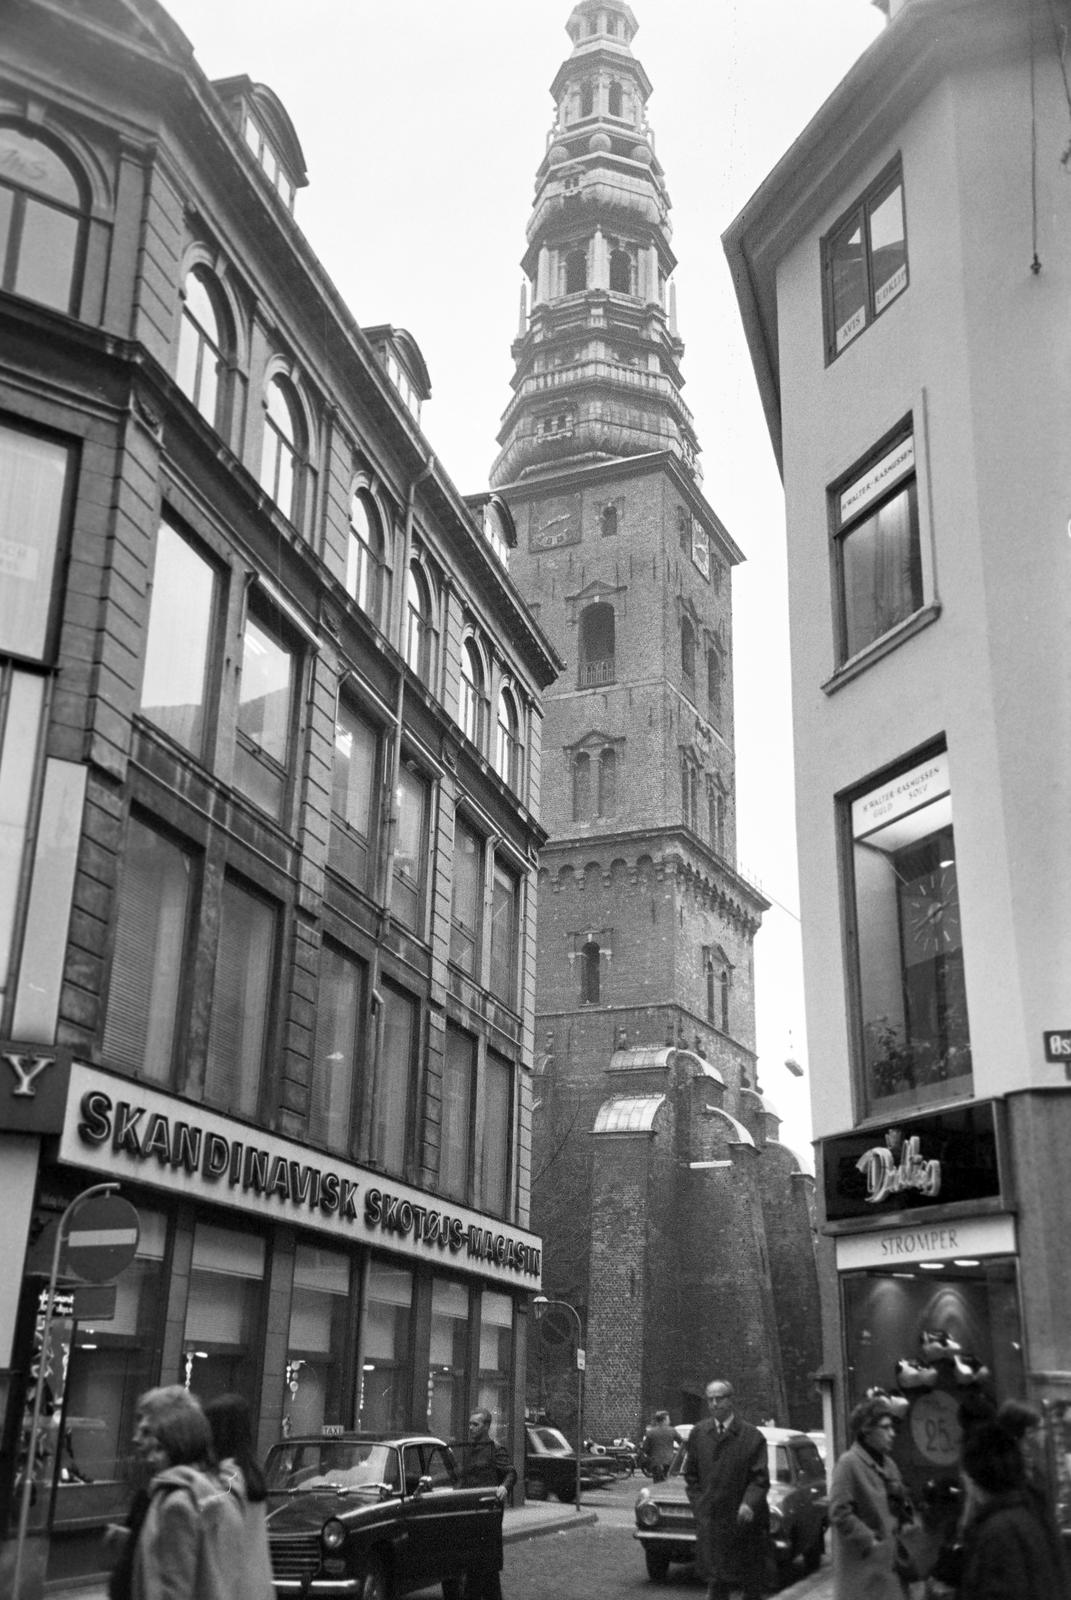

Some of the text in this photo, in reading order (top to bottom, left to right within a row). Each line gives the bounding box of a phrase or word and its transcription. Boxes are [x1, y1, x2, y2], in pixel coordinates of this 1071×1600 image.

[842, 315, 861, 339] AVIS
[897, 767, 940, 794] RASMUSSEN
[3, 1053, 55, 1096] Y
[77, 1090, 541, 1278] SKANDINAVISK SKOTØJS-MAGASIN
[324, 1426, 341, 1436] TAXI
